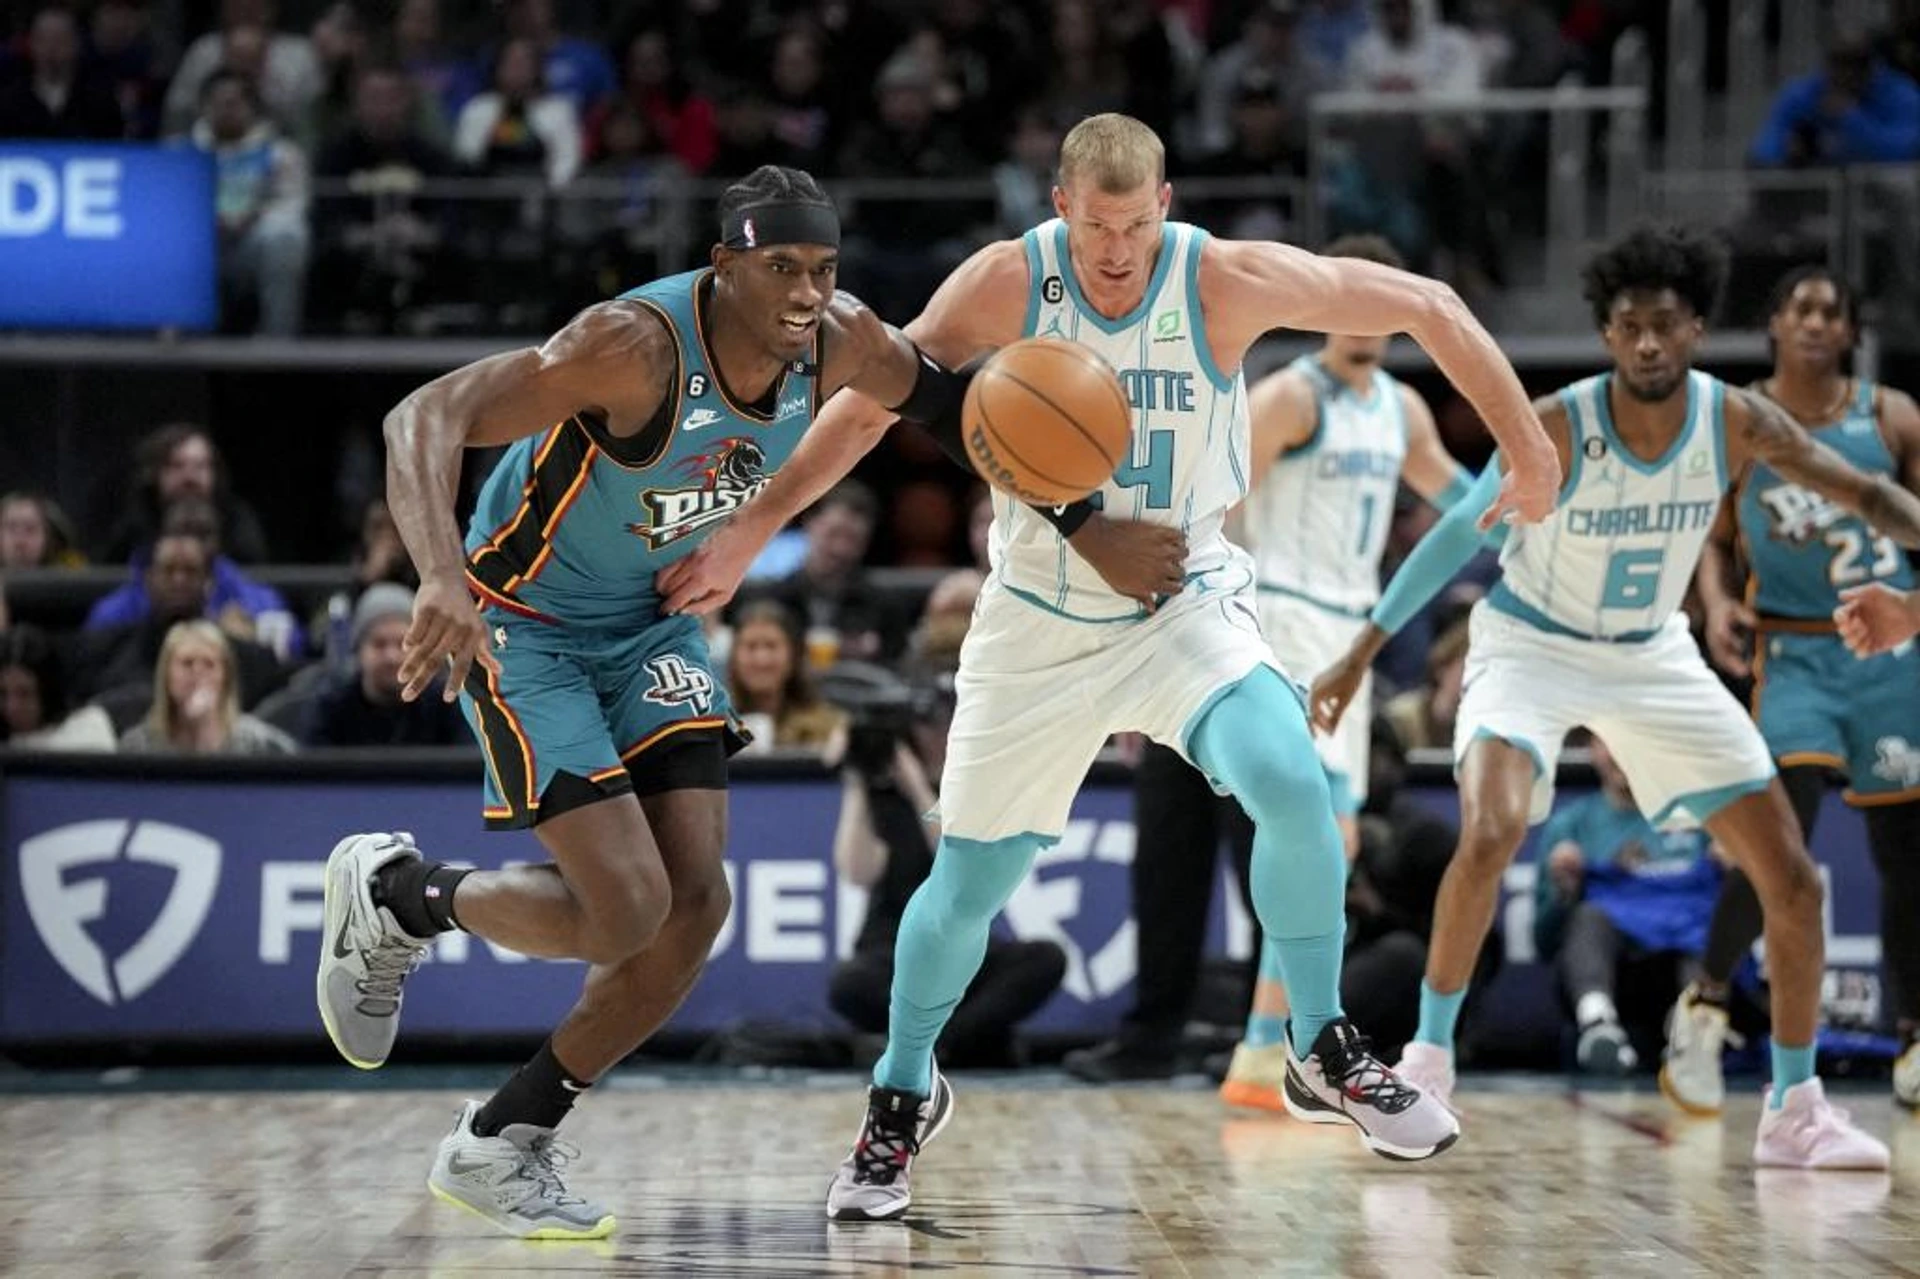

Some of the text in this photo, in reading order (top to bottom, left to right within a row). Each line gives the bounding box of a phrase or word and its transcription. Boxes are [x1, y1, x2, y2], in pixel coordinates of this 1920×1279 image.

[1050, 277, 1062, 299] 6
[688, 375, 705, 397] 6
[1601, 548, 1665, 609] 6
